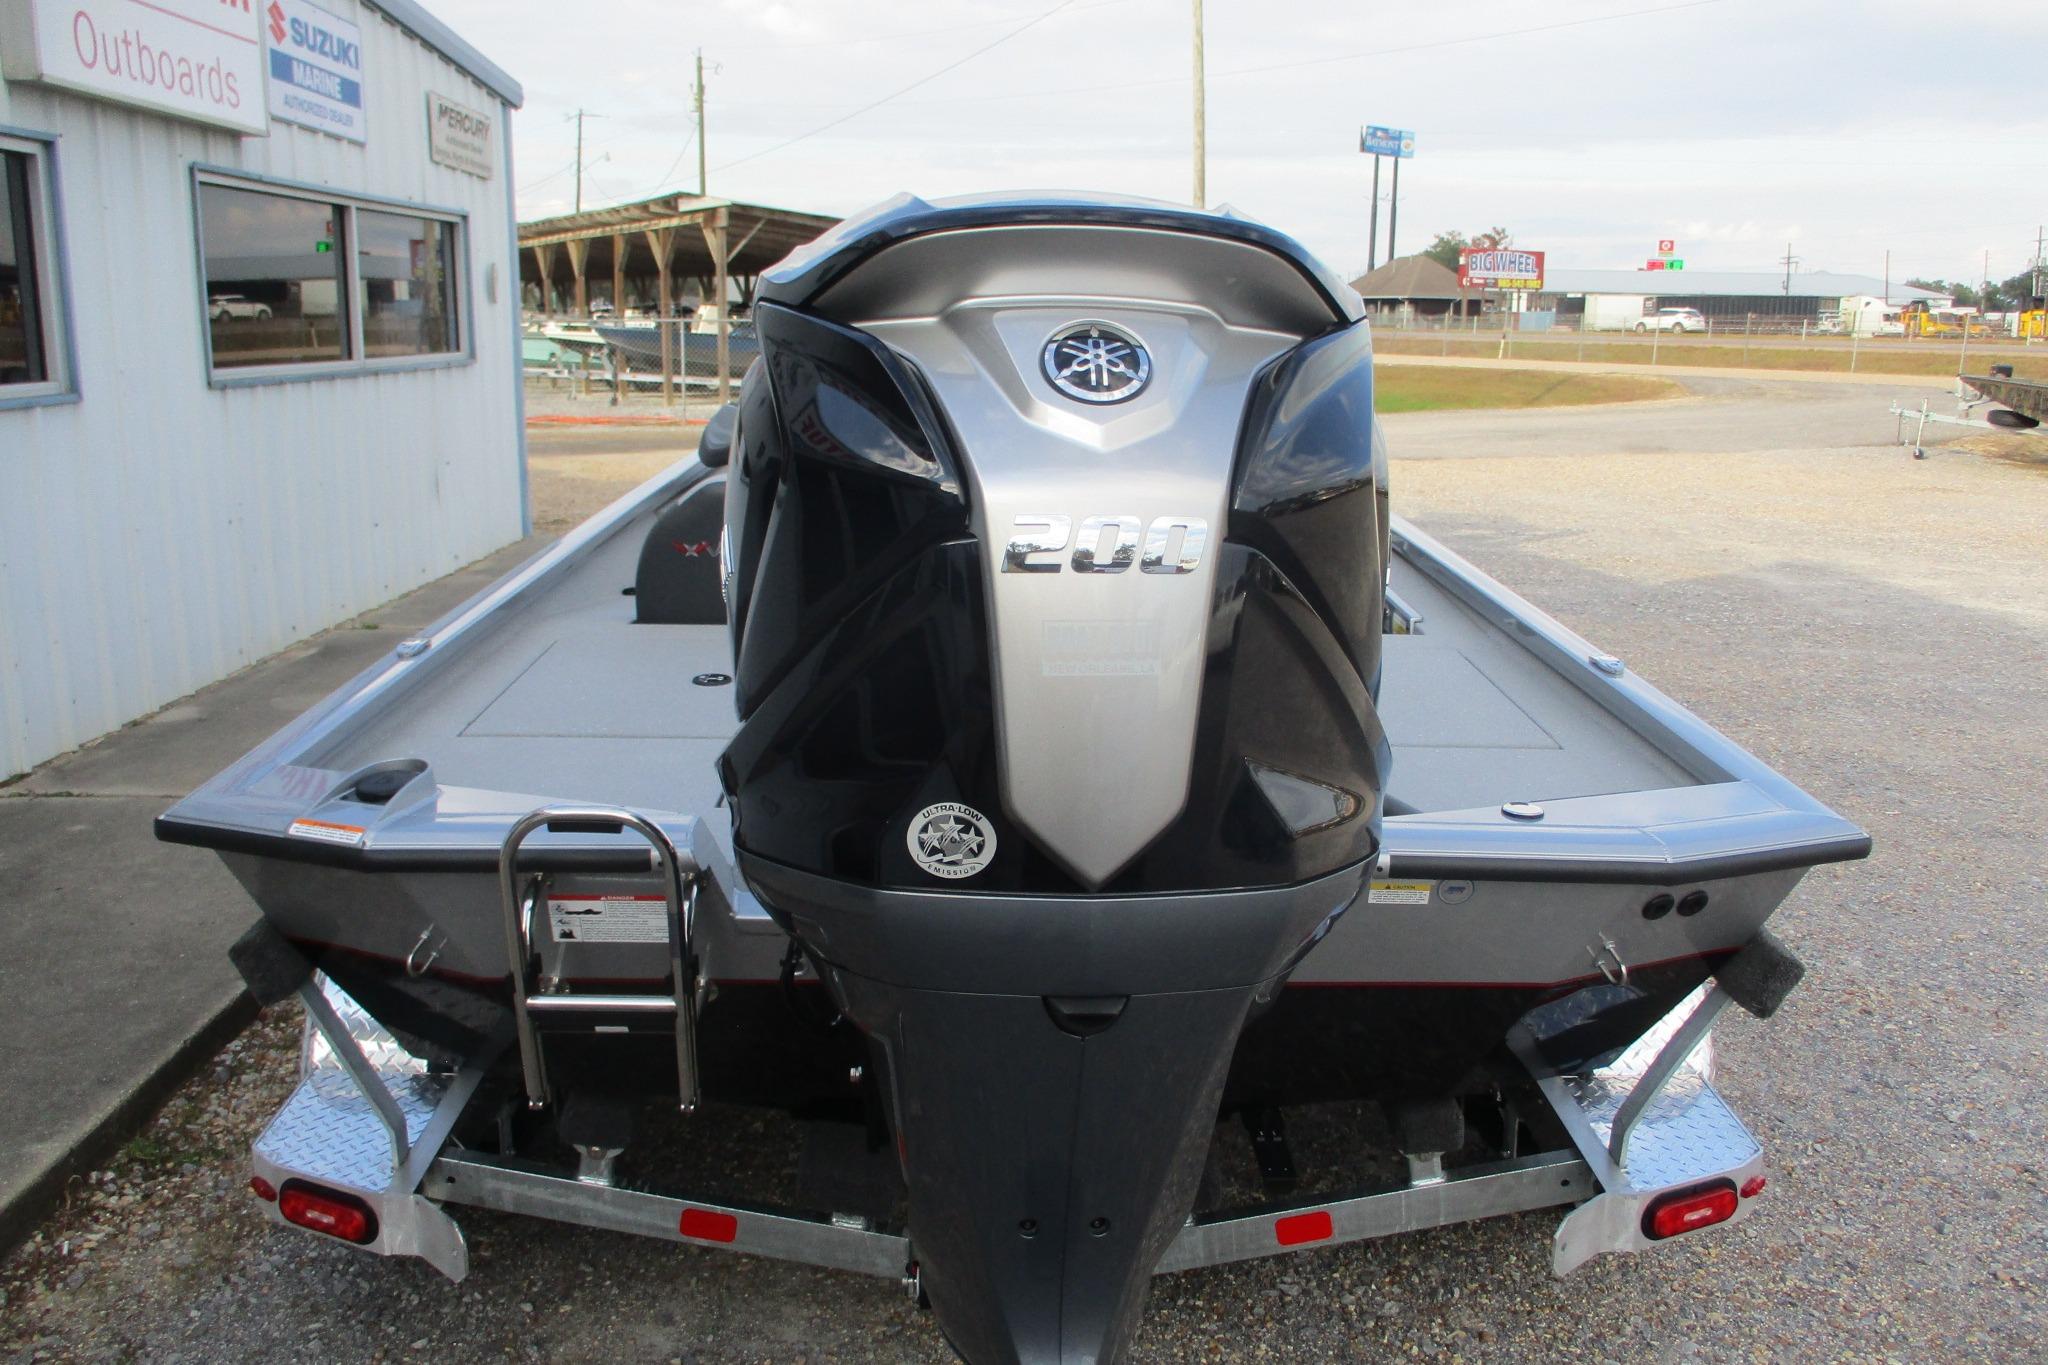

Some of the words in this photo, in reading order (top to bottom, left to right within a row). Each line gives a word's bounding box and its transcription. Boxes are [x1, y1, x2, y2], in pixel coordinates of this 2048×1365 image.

[72, 10, 241, 109] Outboards
[290, 16, 360, 70] SUZUKI
[292, 59, 343, 100] MARINE
[283, 93, 329, 120] AUTHORIZED
[328, 107, 354, 127] DEALER
[437, 102, 491, 141] MERCURY
[1469, 252, 1493, 272] BIG
[1494, 251, 1538, 274] WHEEL
[1001, 513, 1208, 575] 200
[927, 863, 976, 876] EMISSION
